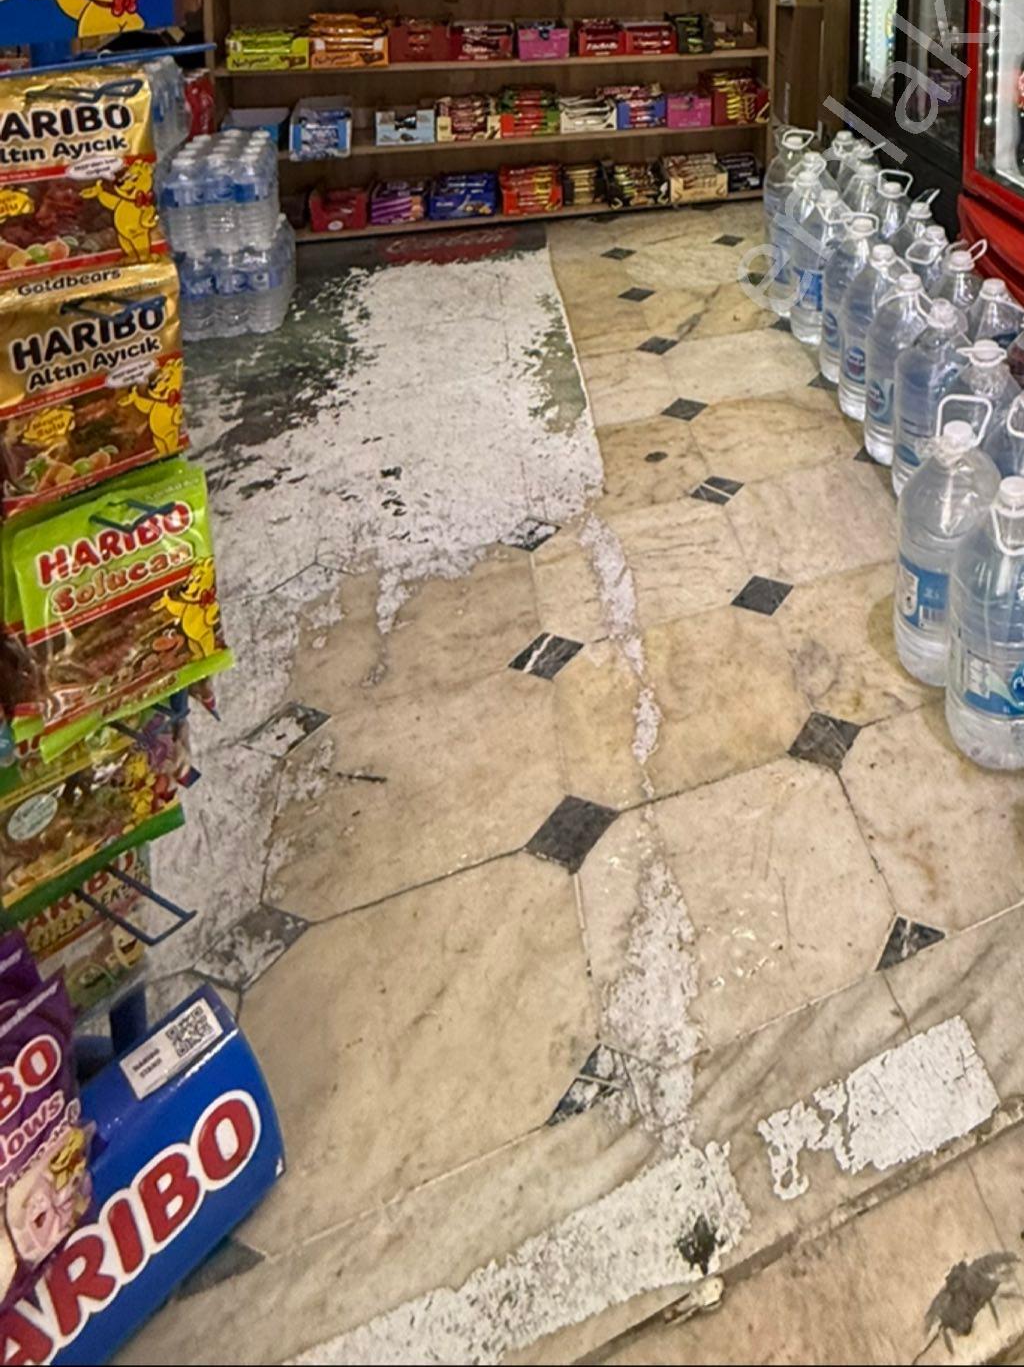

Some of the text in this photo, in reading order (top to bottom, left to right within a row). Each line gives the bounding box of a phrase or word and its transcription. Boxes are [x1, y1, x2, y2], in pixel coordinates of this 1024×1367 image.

[0, 103, 132, 142] ARIBO
[0, 147, 46, 165] ltın
[17, 268, 122, 297] Goldbears
[12, 302, 165, 372] HARIBO
[29, 359, 88, 391] Altın
[92, 336, 161, 371] Ayıcık
[37, 501, 193, 586] HARIBO
[51, 542, 194, 616] Solucan
[0, 1090, 262, 1367] ARIBO
